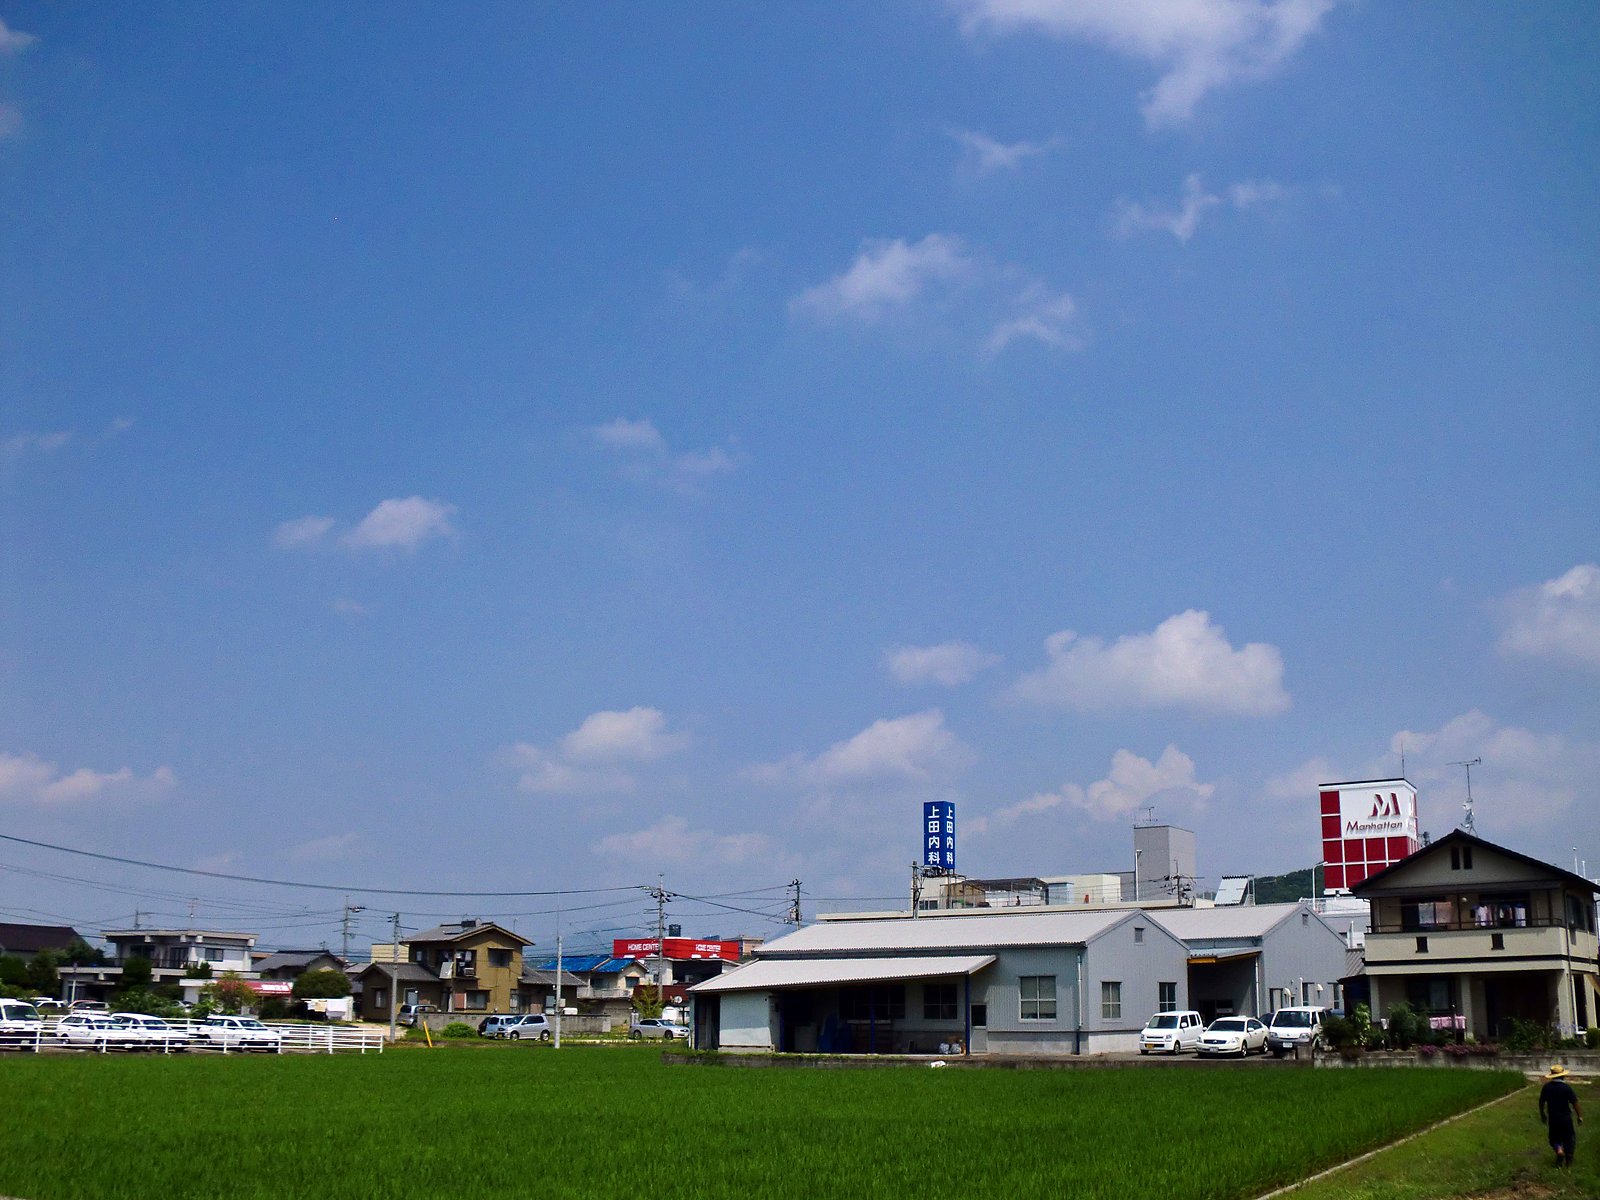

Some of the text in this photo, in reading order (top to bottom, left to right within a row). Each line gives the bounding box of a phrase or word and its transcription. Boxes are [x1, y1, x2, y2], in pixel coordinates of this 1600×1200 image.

[927, 805, 940, 865] 上田内科
[1346, 820, 1403, 831] Manhattan
